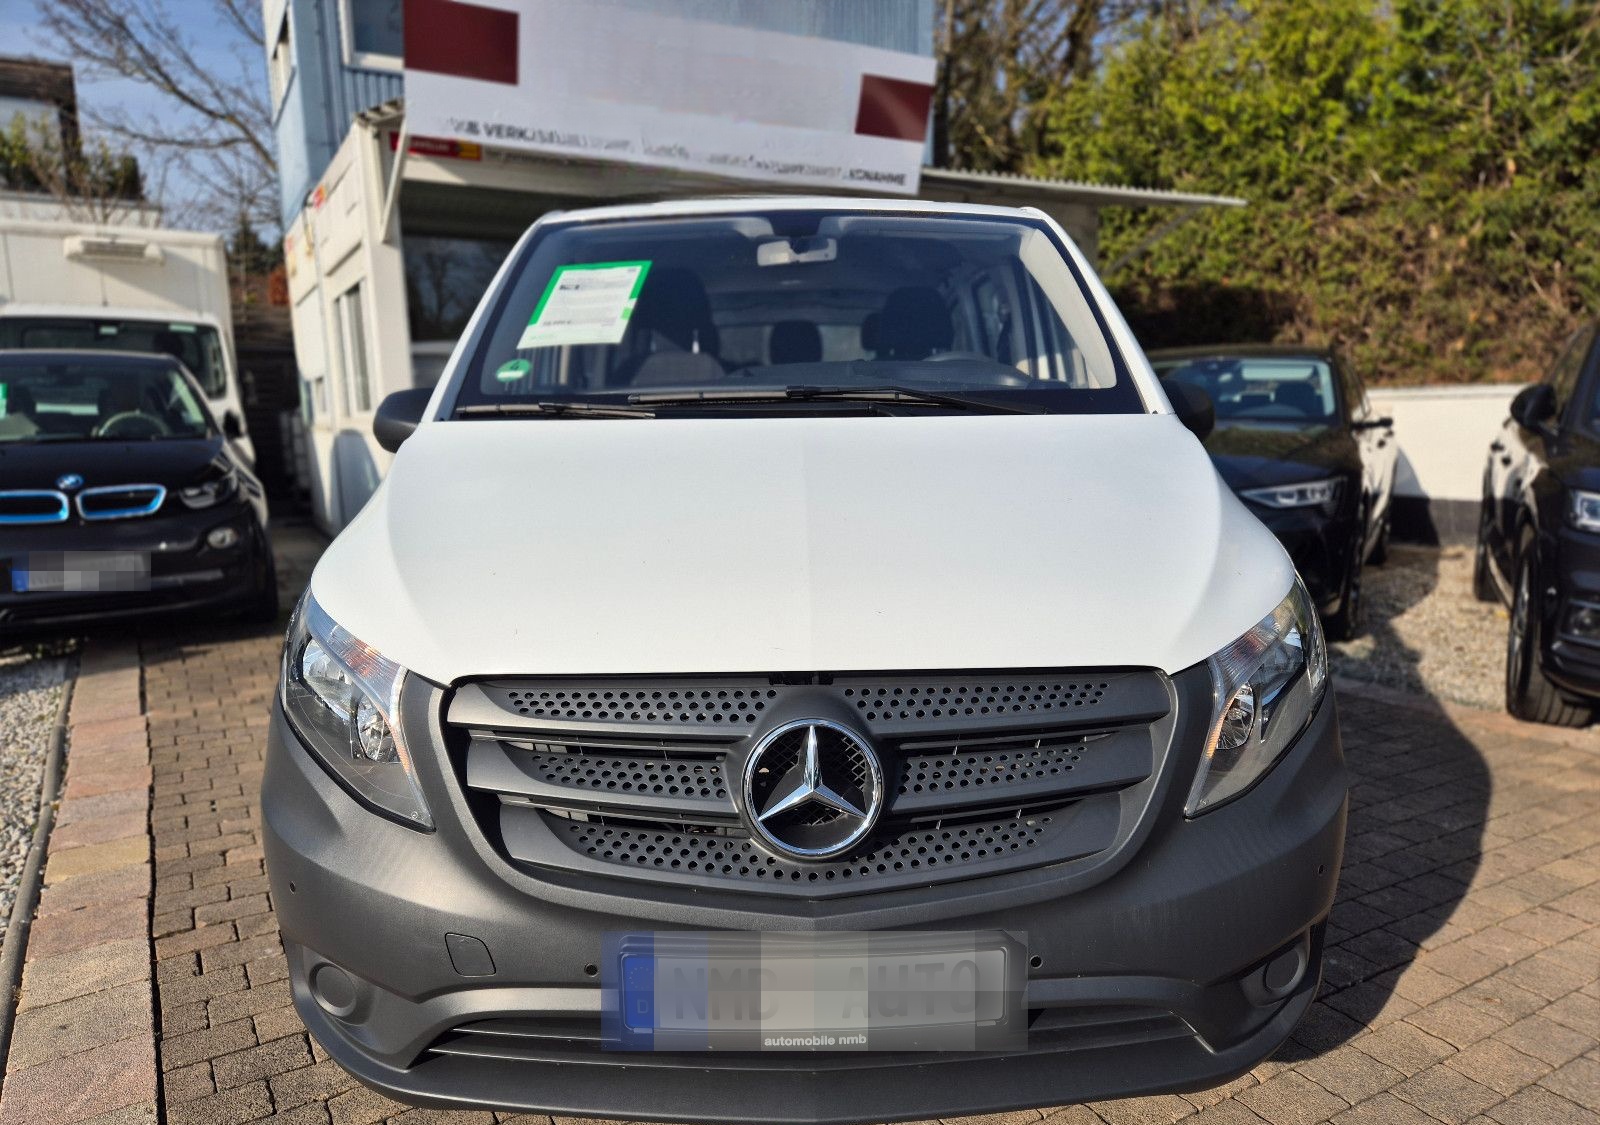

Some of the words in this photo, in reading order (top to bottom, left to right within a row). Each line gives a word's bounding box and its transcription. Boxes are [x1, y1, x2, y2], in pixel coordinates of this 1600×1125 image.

[842, 959, 981, 1020] AUTO
[764, 1035, 836, 1046] automobile
[838, 1034, 868, 1045] nmb
